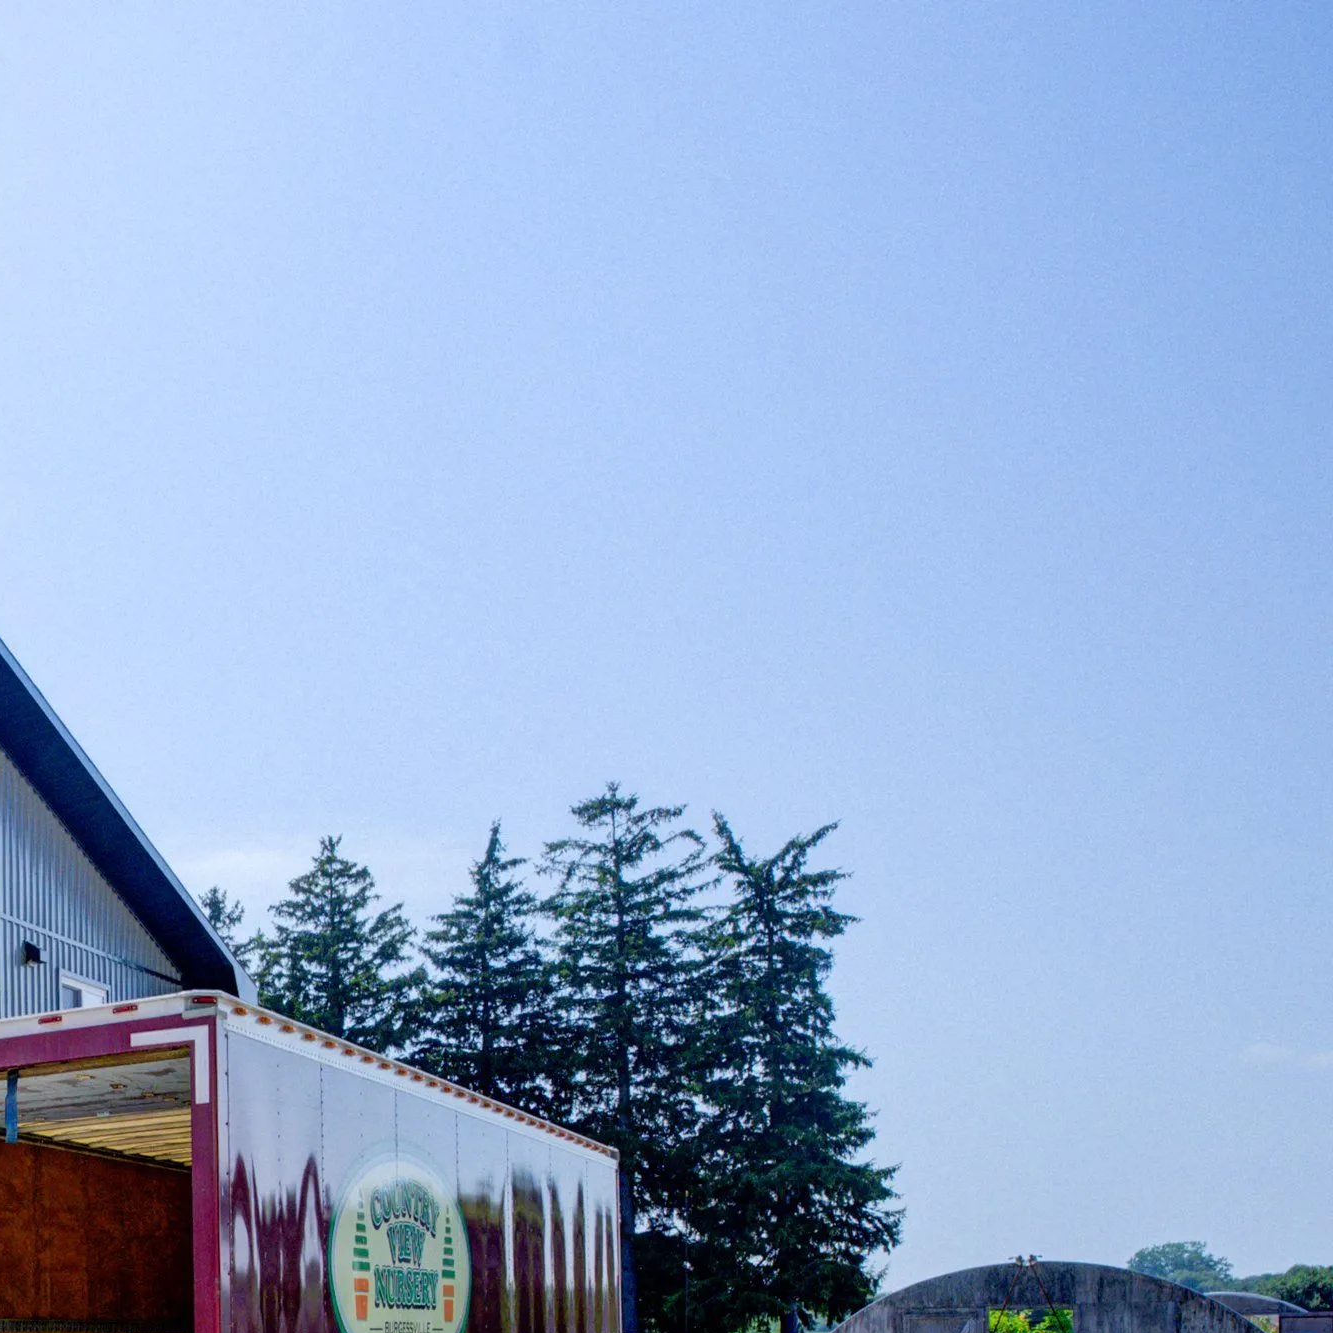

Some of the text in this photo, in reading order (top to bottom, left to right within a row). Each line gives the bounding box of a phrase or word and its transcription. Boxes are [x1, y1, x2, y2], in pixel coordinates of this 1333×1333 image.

[370, 1178, 440, 1239] COUNTRY
[386, 1221, 426, 1268] VIEW
[374, 1264, 439, 1310] NURSERY
